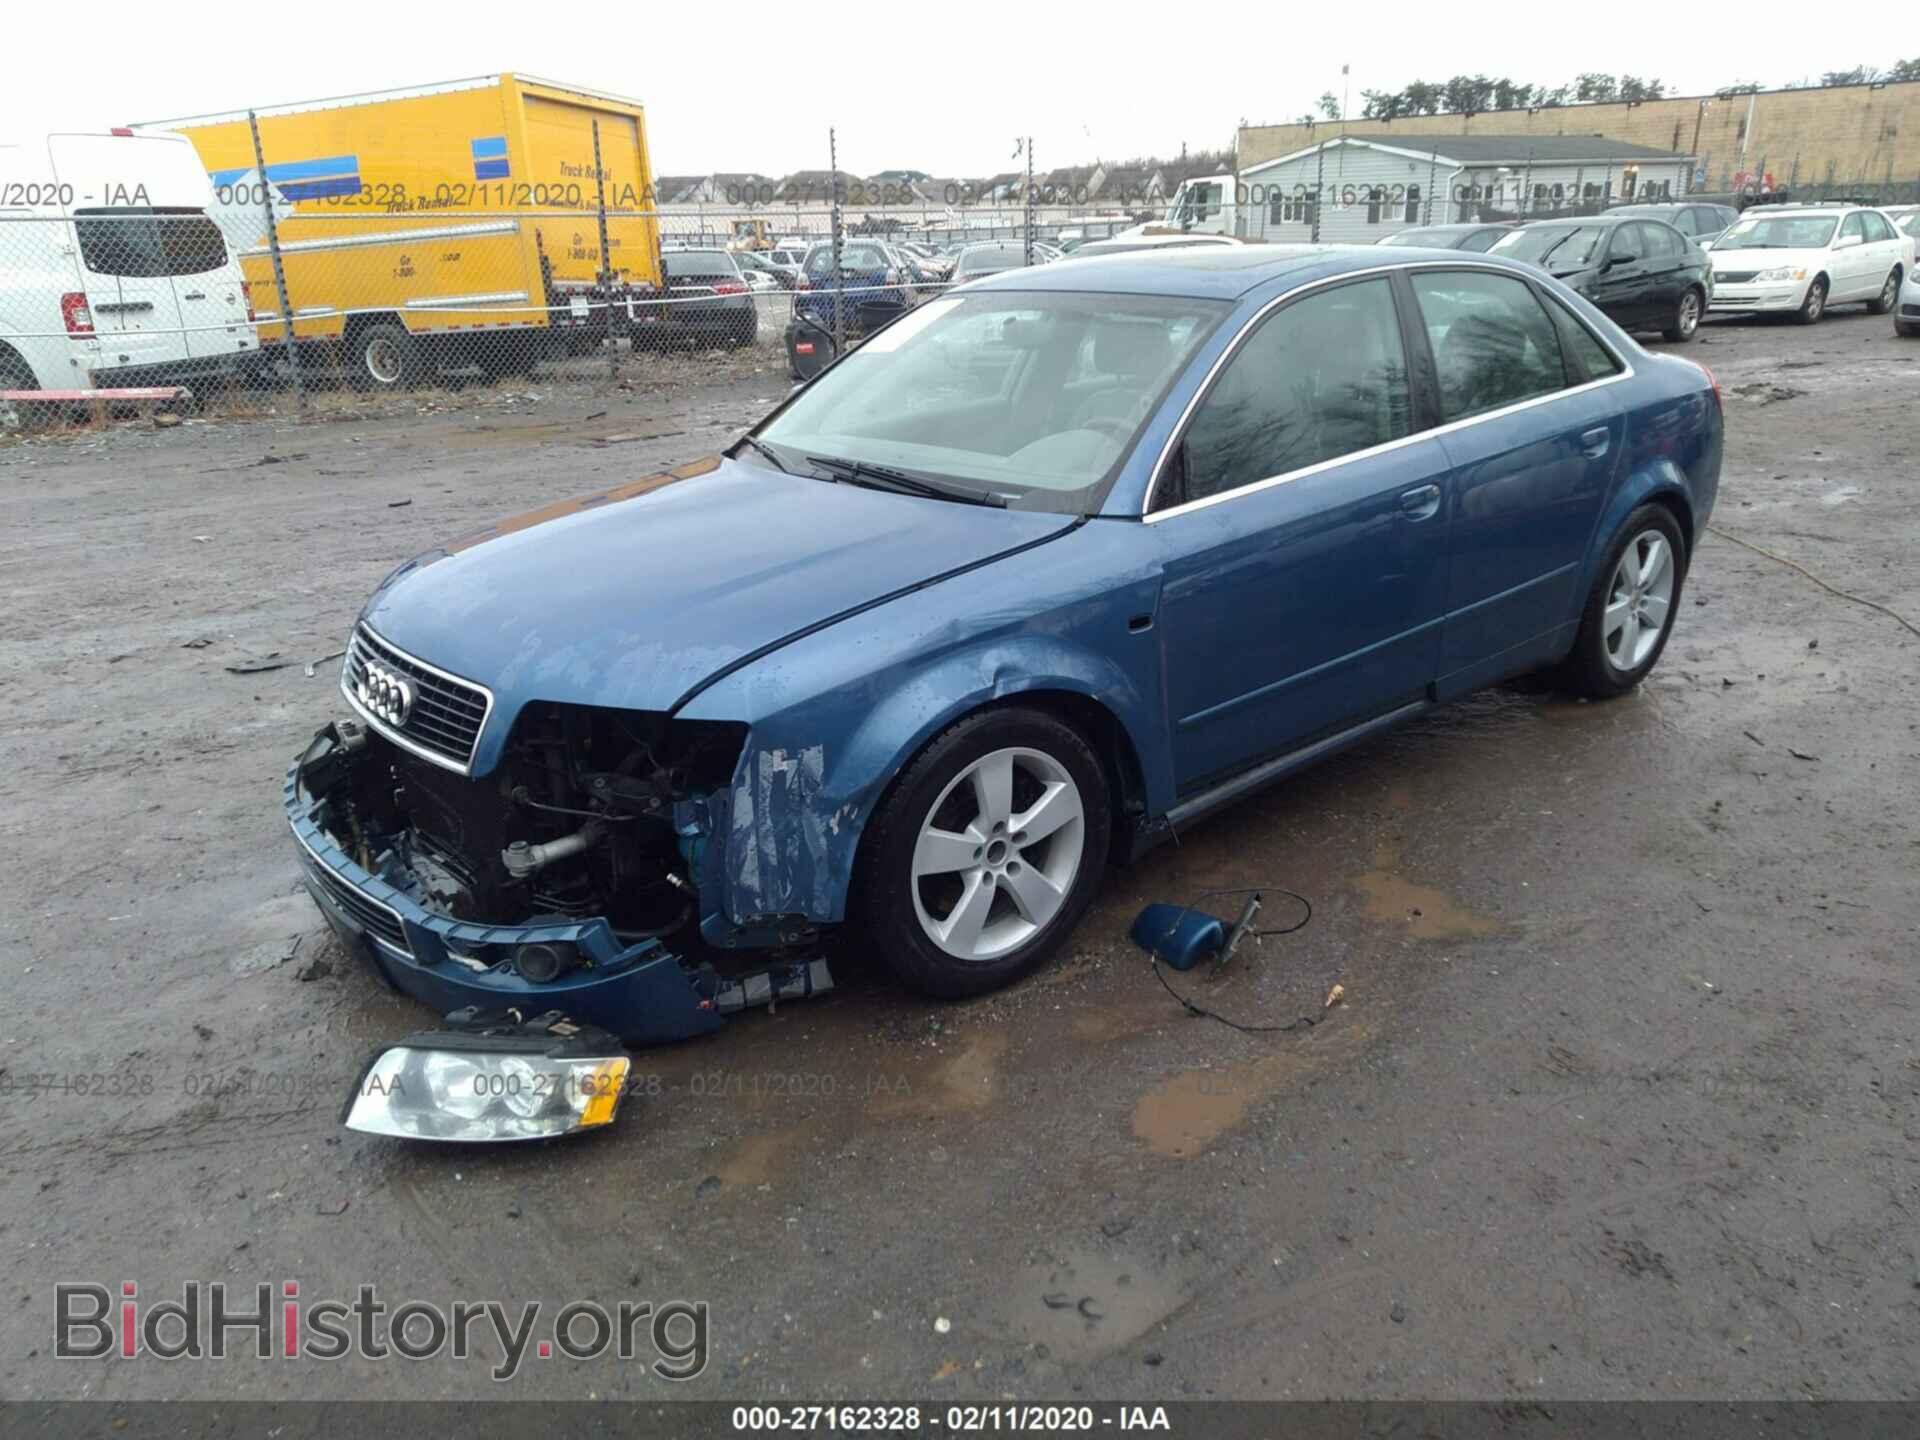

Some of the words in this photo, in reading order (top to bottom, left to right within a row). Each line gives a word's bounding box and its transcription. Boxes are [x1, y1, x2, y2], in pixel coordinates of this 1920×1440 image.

[560, 161, 582, 178] Truck
[585, 164, 612, 181] Real
[386, 198, 415, 213] Truck
